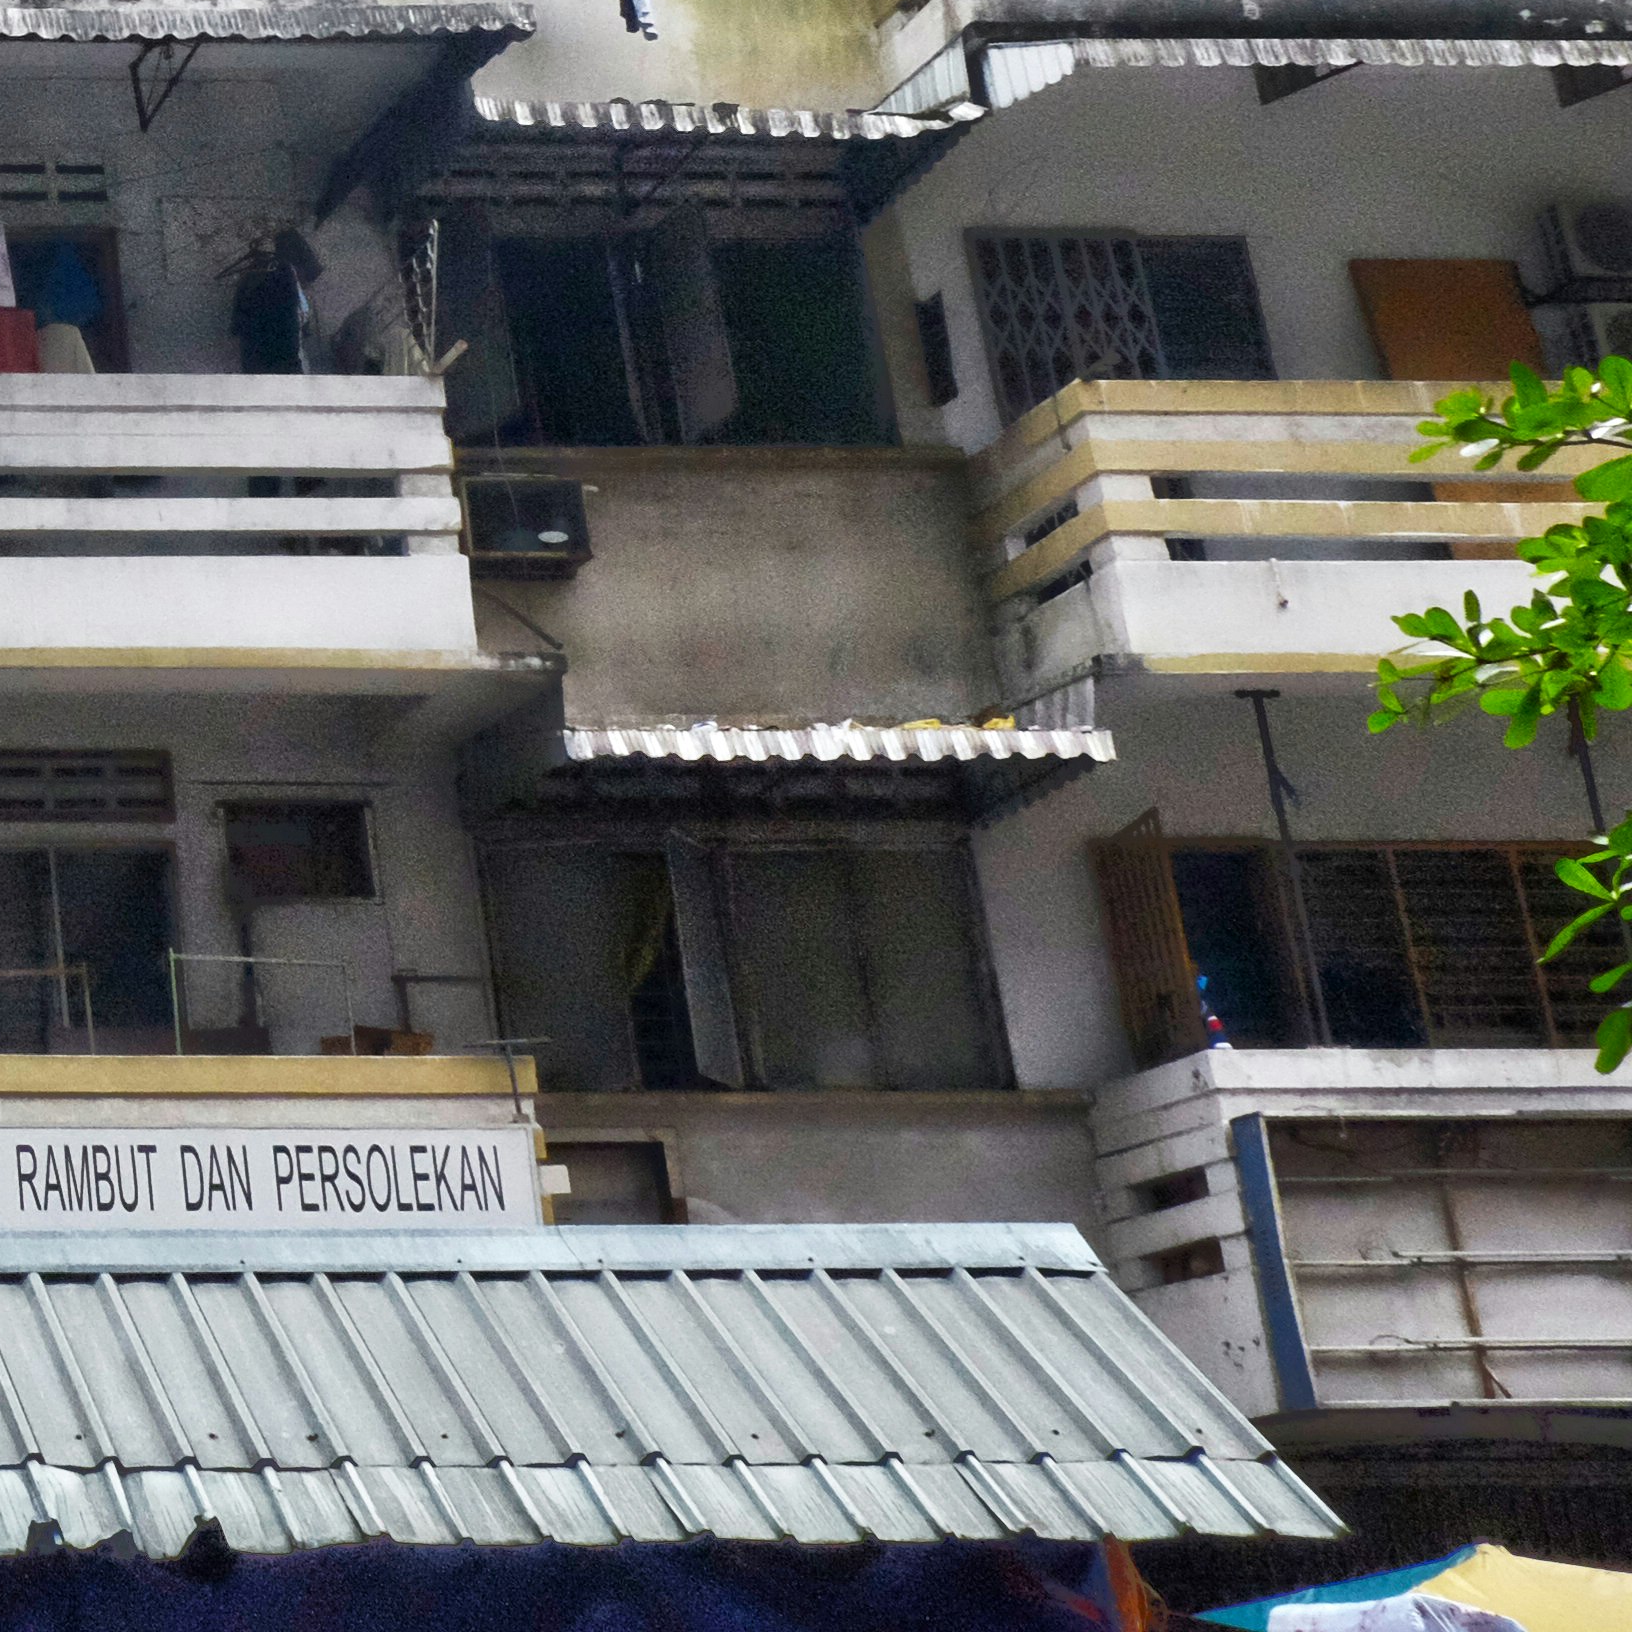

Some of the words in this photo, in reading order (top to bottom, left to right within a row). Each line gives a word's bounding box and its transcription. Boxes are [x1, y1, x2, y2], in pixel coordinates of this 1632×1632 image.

[16, 1143, 158, 1212] RAMBUT
[179, 1143, 254, 1212] DAN
[272, 1143, 507, 1213] PERSOLEKAN
